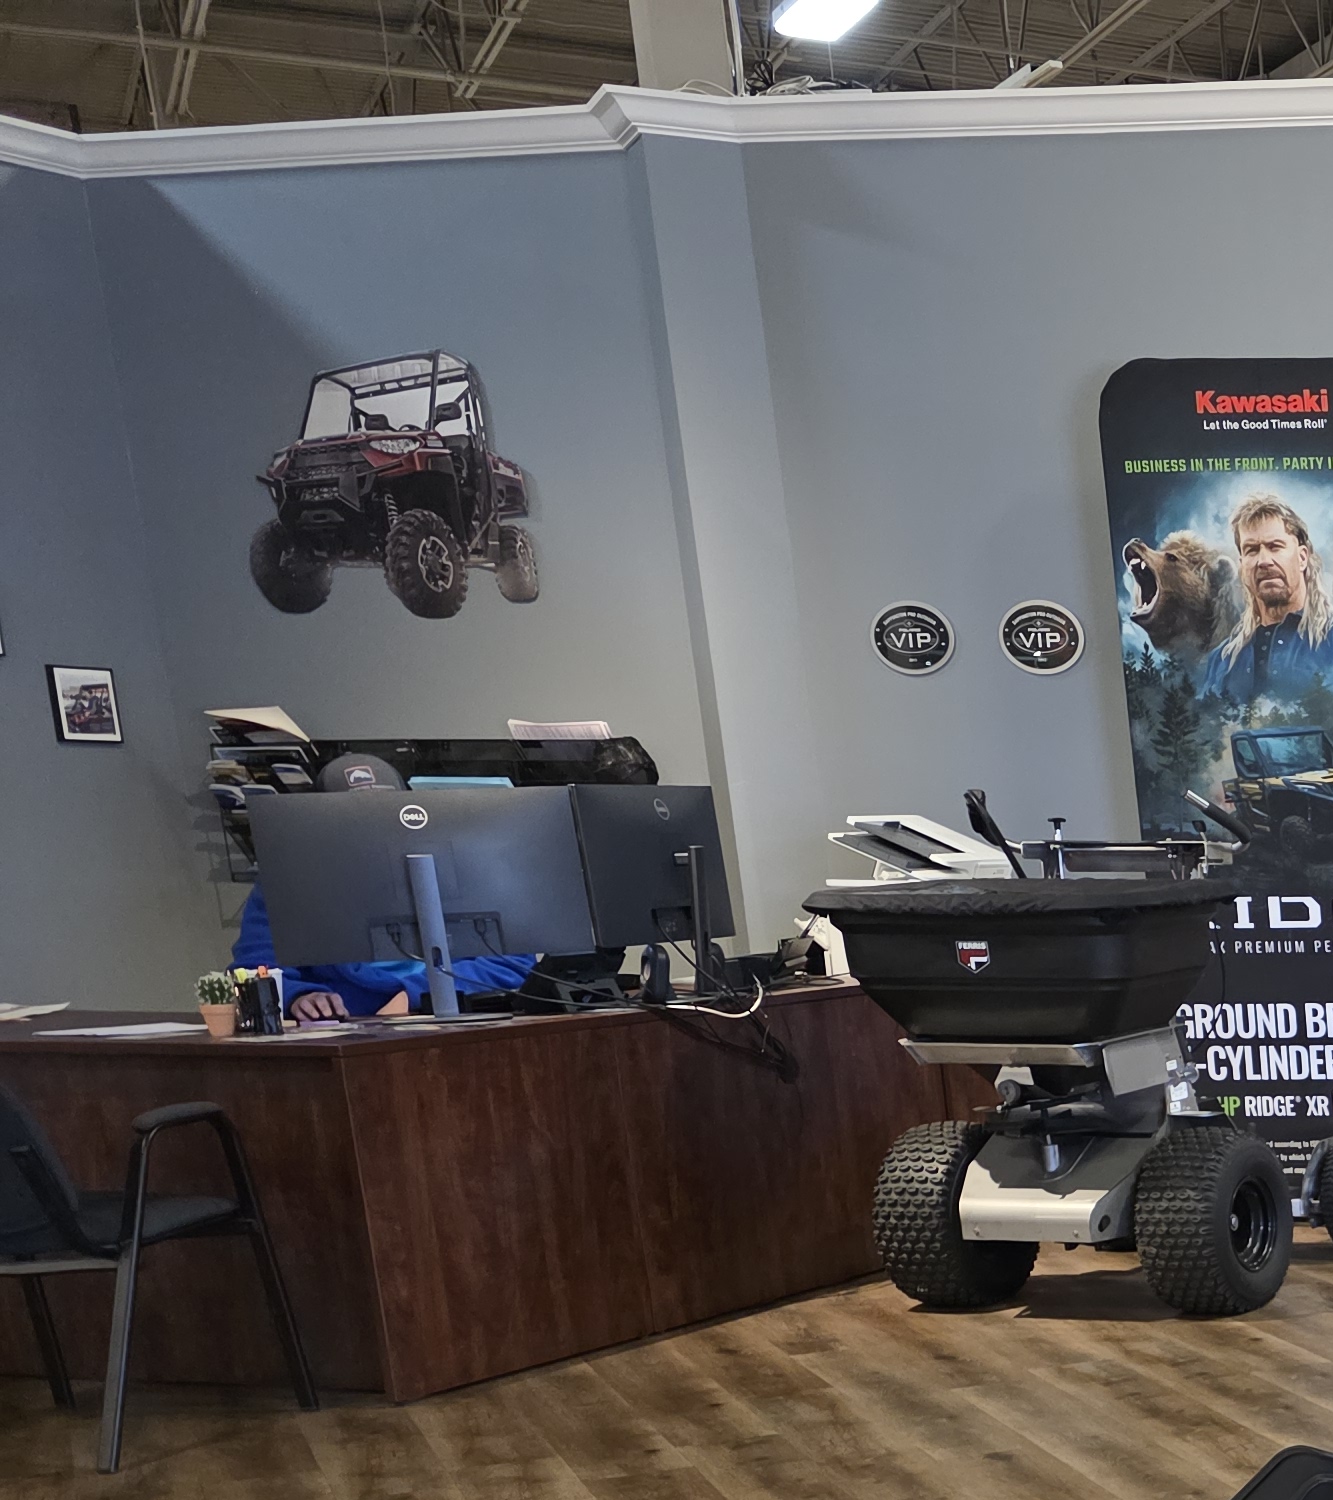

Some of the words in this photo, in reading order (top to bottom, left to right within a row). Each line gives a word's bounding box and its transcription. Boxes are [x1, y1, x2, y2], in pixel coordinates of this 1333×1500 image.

[1195, 389, 1329, 414] Kawasaki
[1203, 420, 1220, 430] Let
[1222, 420, 1239, 430] the
[1241, 420, 1269, 430] Good
[1270, 419, 1302, 430] Times
[1124, 459, 1187, 474] BUSINESS
[1190, 458, 1204, 472] IN
[1206, 458, 1231, 471] THE
[1234, 457, 1279, 471] FRONT.
[1283, 456, 1324, 470] PARTY
[890, 632, 931, 648] VIP
[1019, 632, 1061, 648] VIP
[403, 813, 425, 821] DELL
[1235, 940, 1305, 953] PREMIUM
[1175, 1002, 1297, 1039] GROUND
[1245, 1095, 1296, 1117] RIDGE
[1305, 1096, 1330, 1116] XR
